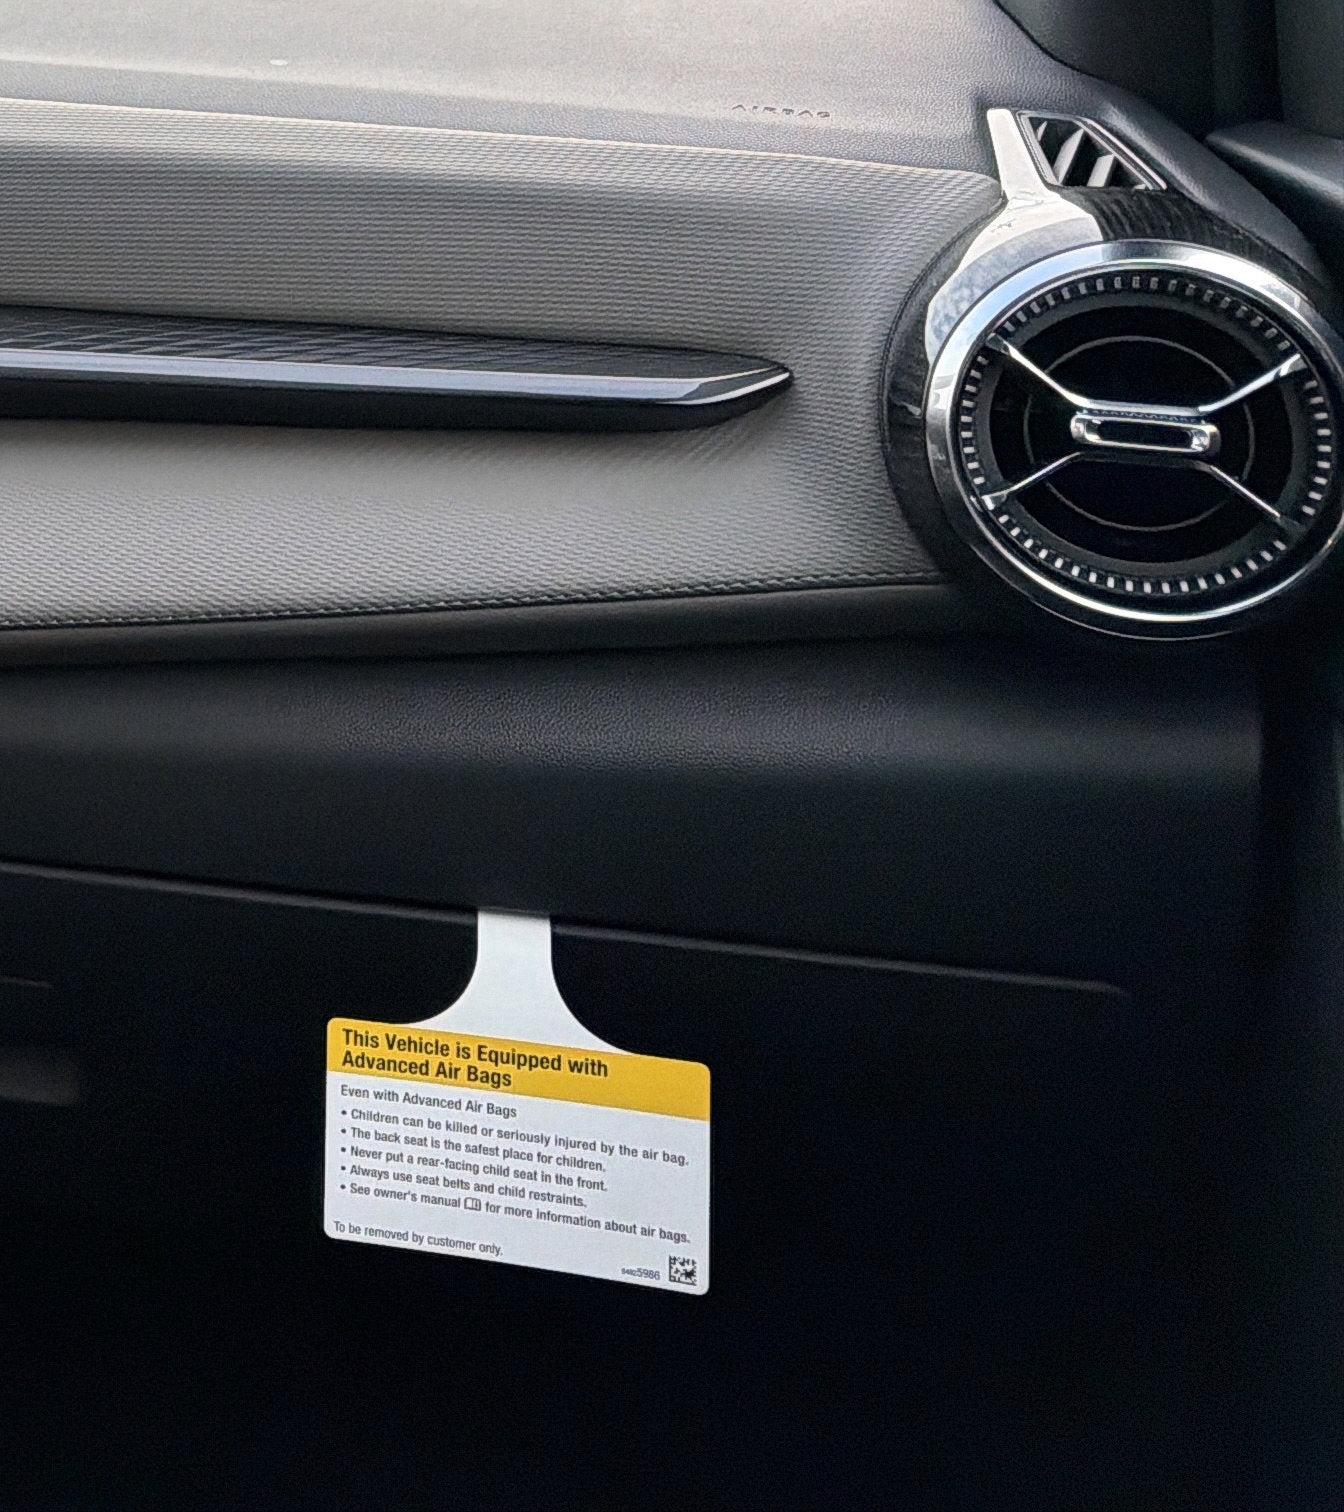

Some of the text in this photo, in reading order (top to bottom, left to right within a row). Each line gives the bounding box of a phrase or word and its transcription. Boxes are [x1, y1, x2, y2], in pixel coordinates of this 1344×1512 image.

[341, 1050, 512, 1089] Advanced Air Bags
[342, 1028, 609, 1078] This Vehicle is Equipped with
[340, 1084, 518, 1120] Even with Advanced Air Bags
[351, 1108, 689, 1167] Children can be killed or seriously injured by the air bag.
[351, 1126, 606, 1173] The back seat is the safest place for children.
[350, 1145, 608, 1192] Never put a rear-facing child seat in the front.
[350, 1164, 587, 1208] Always use seat belts and child restraints.
[350, 1183, 691, 1244] See owner's manual for more information about air bags.
[334, 1220, 504, 1257] To be removed by customer only.
